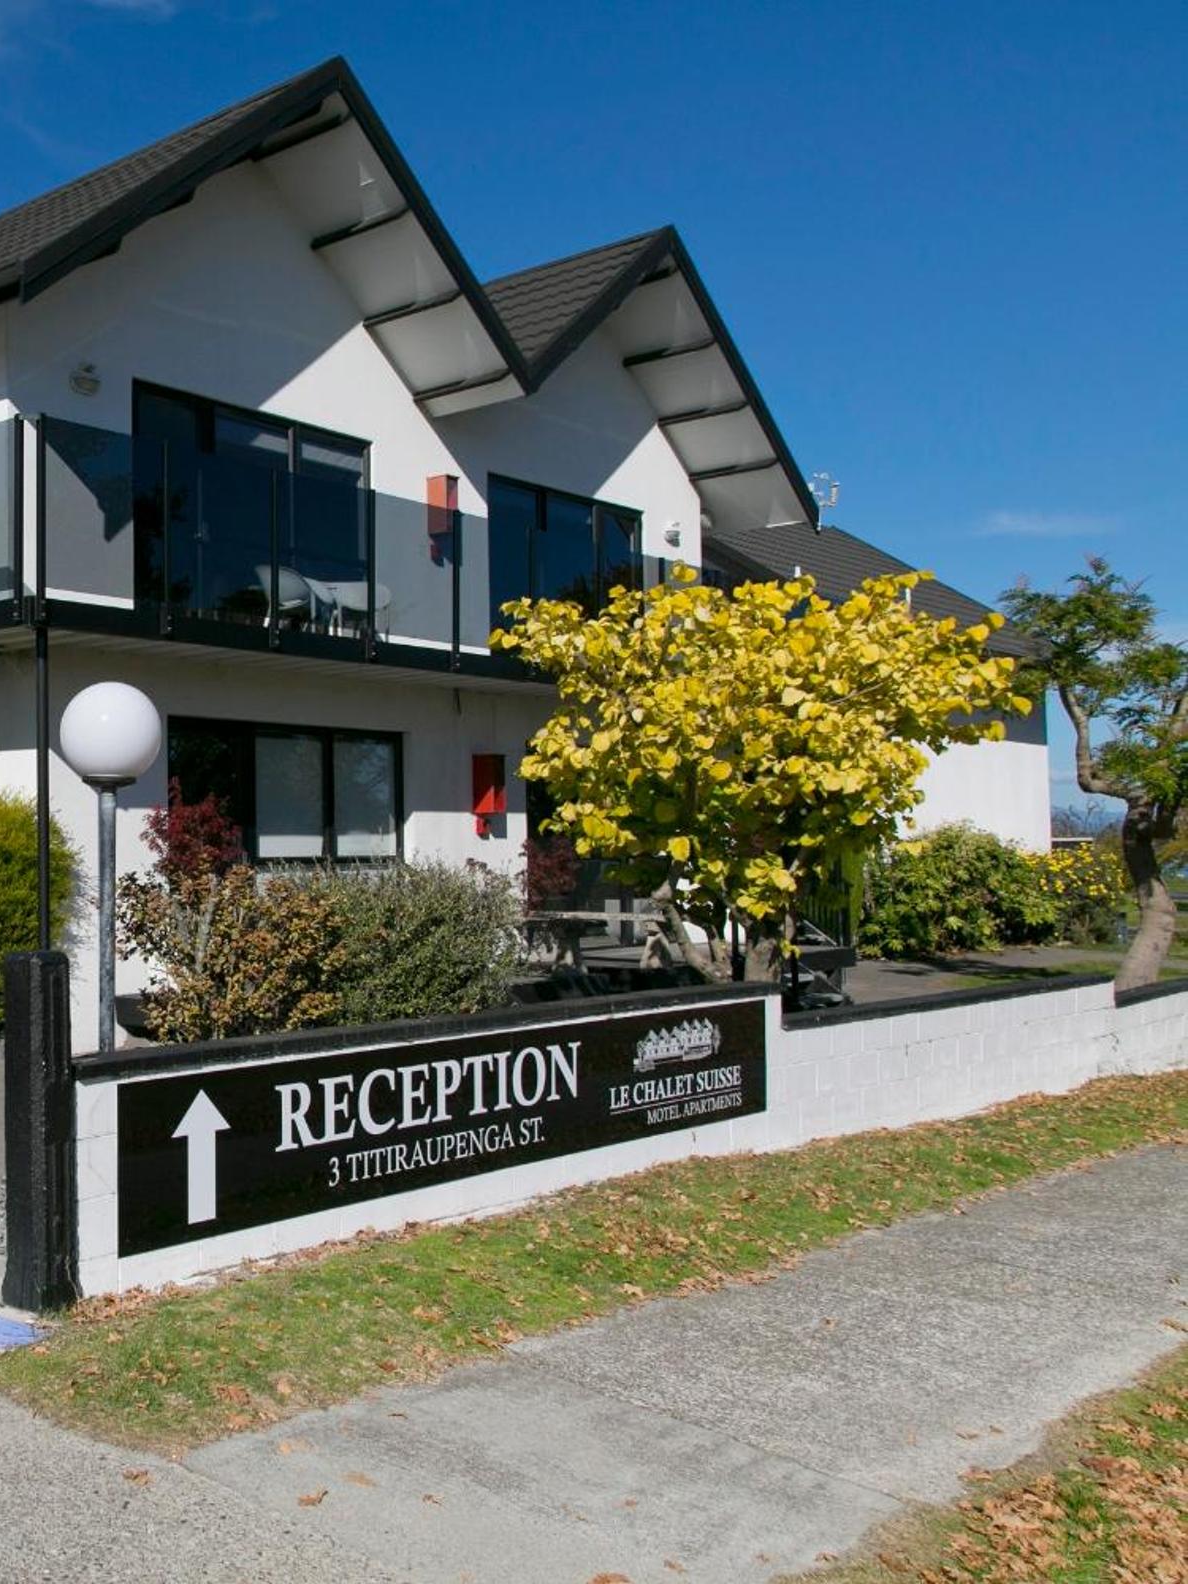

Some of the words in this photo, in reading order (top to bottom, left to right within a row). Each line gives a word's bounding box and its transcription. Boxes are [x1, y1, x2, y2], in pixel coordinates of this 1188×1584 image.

[275, 1042, 581, 1152] RECEPTION
[609, 1086, 630, 1109] LE
[633, 1073, 693, 1104] CHALET
[696, 1065, 743, 1092] SUISSE
[647, 1106, 682, 1125] MOTEL
[683, 1092, 743, 1117] APARTMENTS
[328, 1156, 340, 1187] 3
[346, 1122, 514, 1182] TITIRAUPENGA
[519, 1116, 545, 1145] ST.
